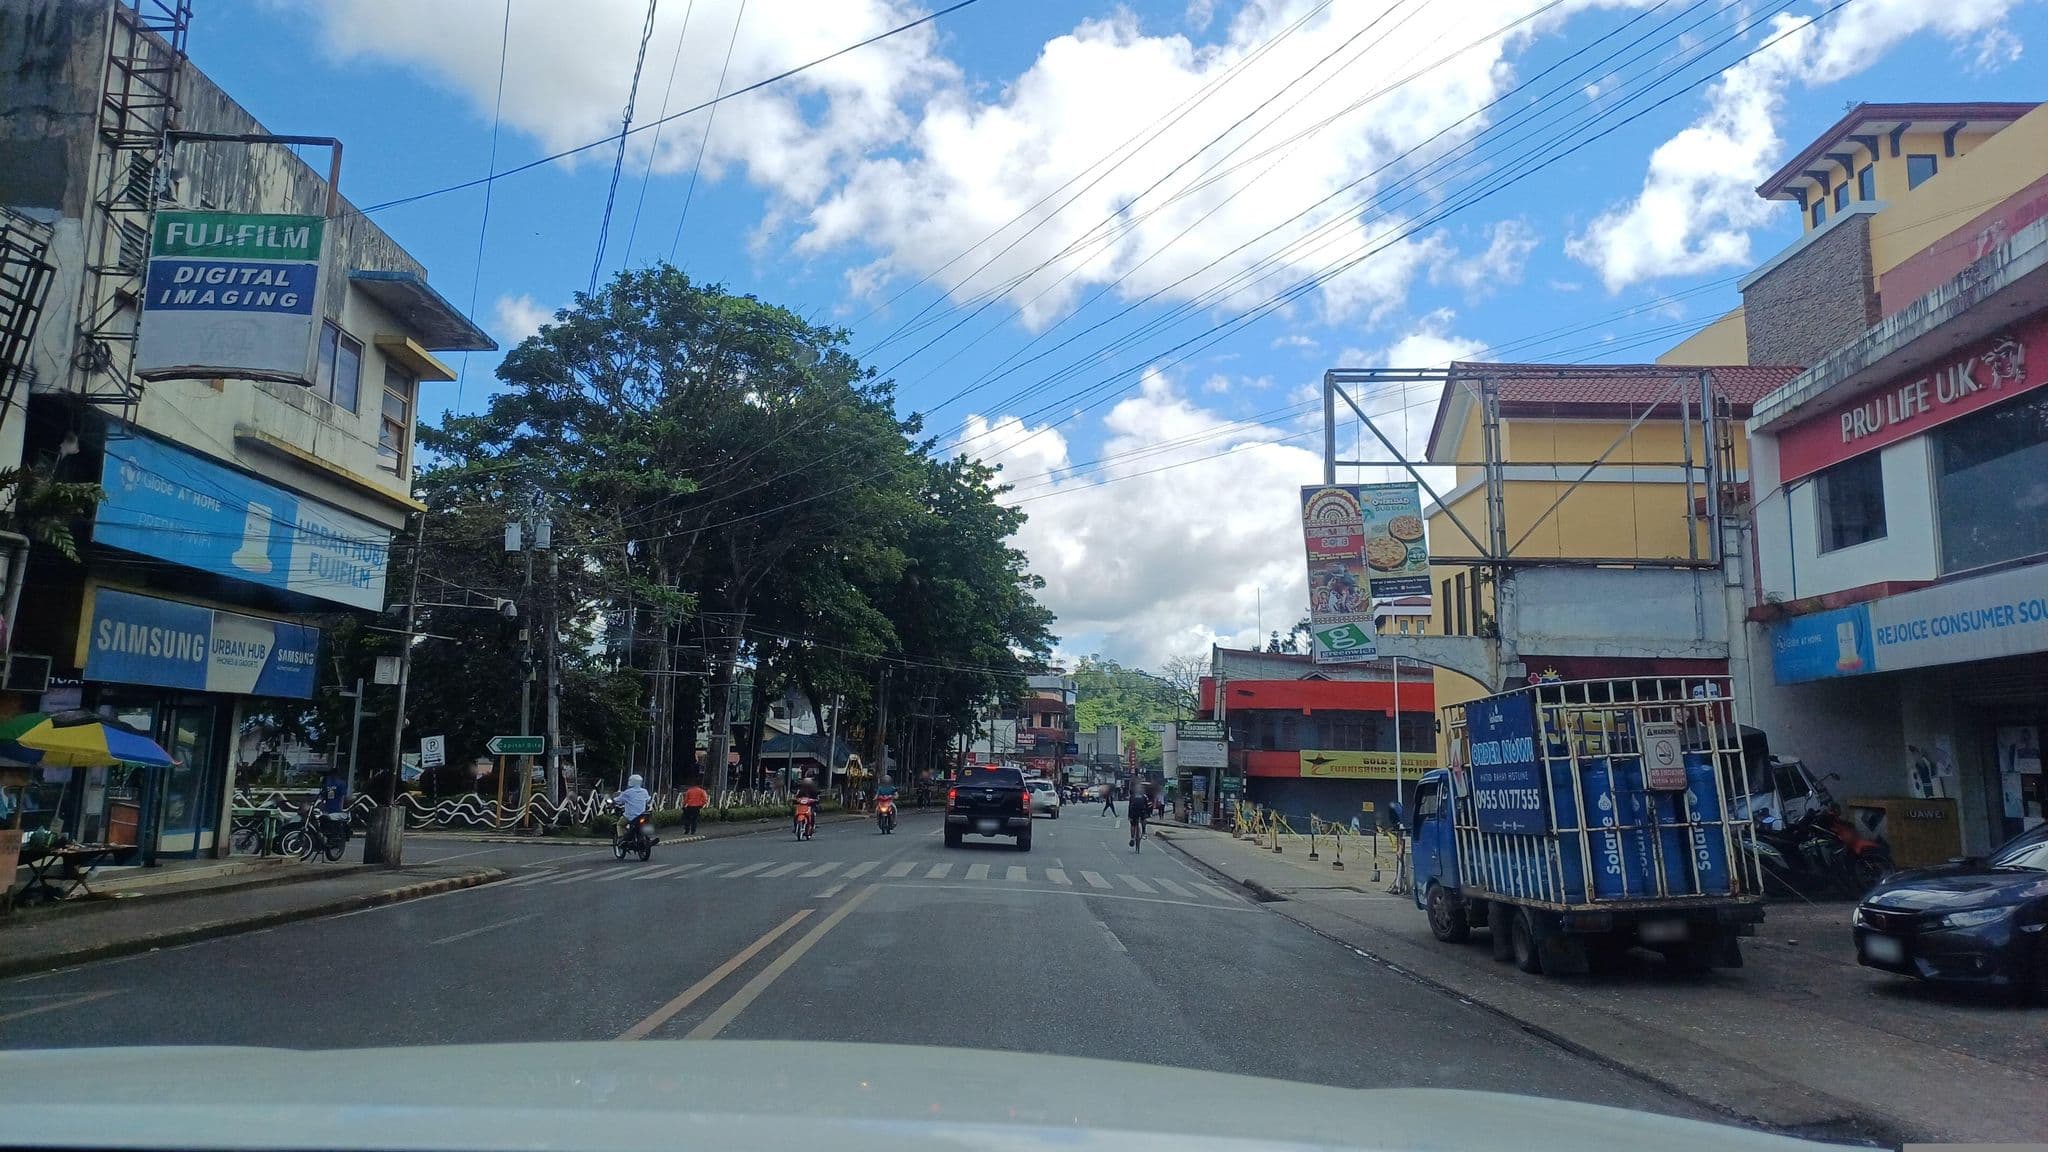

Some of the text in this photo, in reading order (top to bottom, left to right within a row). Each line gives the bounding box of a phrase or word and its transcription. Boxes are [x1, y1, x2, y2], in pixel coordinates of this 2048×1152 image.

[166, 222, 310, 249] FUJIFILM
[173, 266, 290, 287] DIGITAL
[160, 289, 298, 307] IMAGING
[1841, 399, 1882, 443] PRU
[1887, 378, 1931, 425] LIFE
[193, 491, 221, 512] HOME
[298, 518, 349, 556] URBAN
[308, 551, 371, 590] FUJIFILM
[1877, 619, 1928, 646] REJOICE
[1931, 605, 2015, 637] CONSUMER
[97, 618, 205, 662] SAMSUNG
[211, 638, 266, 660] URBAN HUB
[277, 648, 314, 665] SAMSUNG
[1471, 741, 1502, 766] ORDER
[1476, 788, 1540, 810] 0955 0177555
[1602, 816, 1621, 875] Solane
[1690, 811, 1712, 871] Solane
